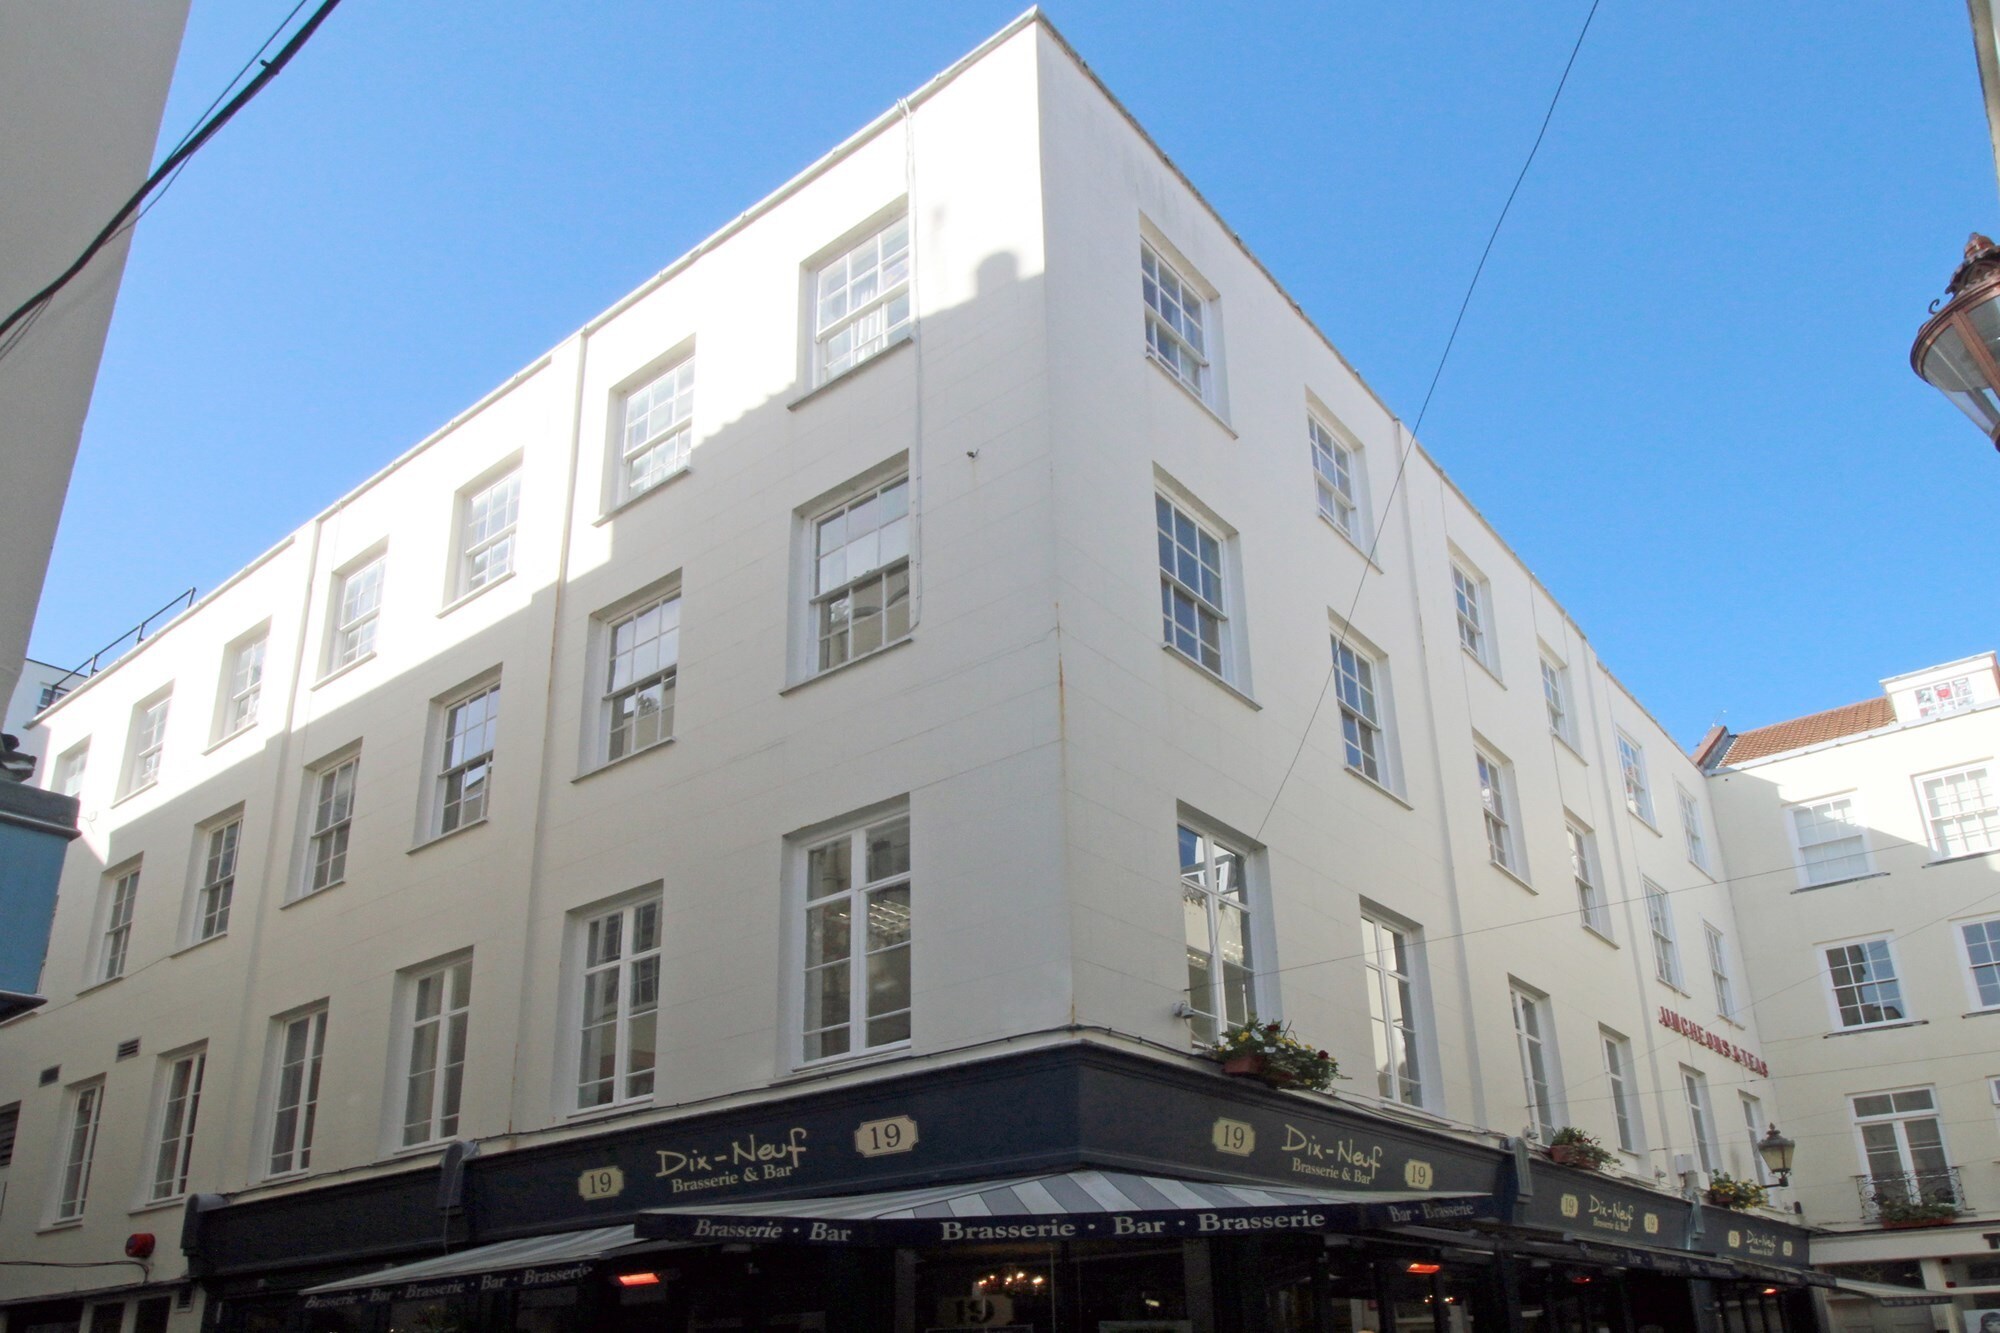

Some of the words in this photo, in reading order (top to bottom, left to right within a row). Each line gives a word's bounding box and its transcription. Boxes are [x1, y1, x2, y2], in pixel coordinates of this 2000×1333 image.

[870, 1123, 902, 1151] 19
[1223, 1124, 1245, 1150] 19
[656, 1127, 807, 1178] Dix-Neuf
[1281, 1123, 1383, 1180] Dix-Neuf
[589, 1172, 612, 1194] 19
[672, 1170, 739, 1194] Brasserie
[743, 1167, 760, 1182] &
[763, 1163, 794, 1180] Bar
[1292, 1157, 1340, 1180] Brasserie
[1341, 1168, 1352, 1182] &
[1354, 1169, 1372, 1185] Bar
[1411, 1164, 1426, 1185] 19
[1388, 1205, 1412, 1222] Bar
[1423, 1202, 1475, 1220] Brasserie
[1564, 1197, 1575, 1214] 19
[693, 1218, 783, 1240] Brasserie
[808, 1222, 852, 1242] Bar
[941, 1218, 1076, 1241] Brasserie
[1112, 1215, 1166, 1236] Bar
[1197, 1209, 1326, 1232] Brasserie
[304, 1292, 359, 1308] Brasserie
[370, 1289, 394, 1303] Bar
[405, 1279, 466, 1299] Brasserie
[480, 1274, 508, 1290] Bar
[522, 1263, 594, 1285] Brasserie
